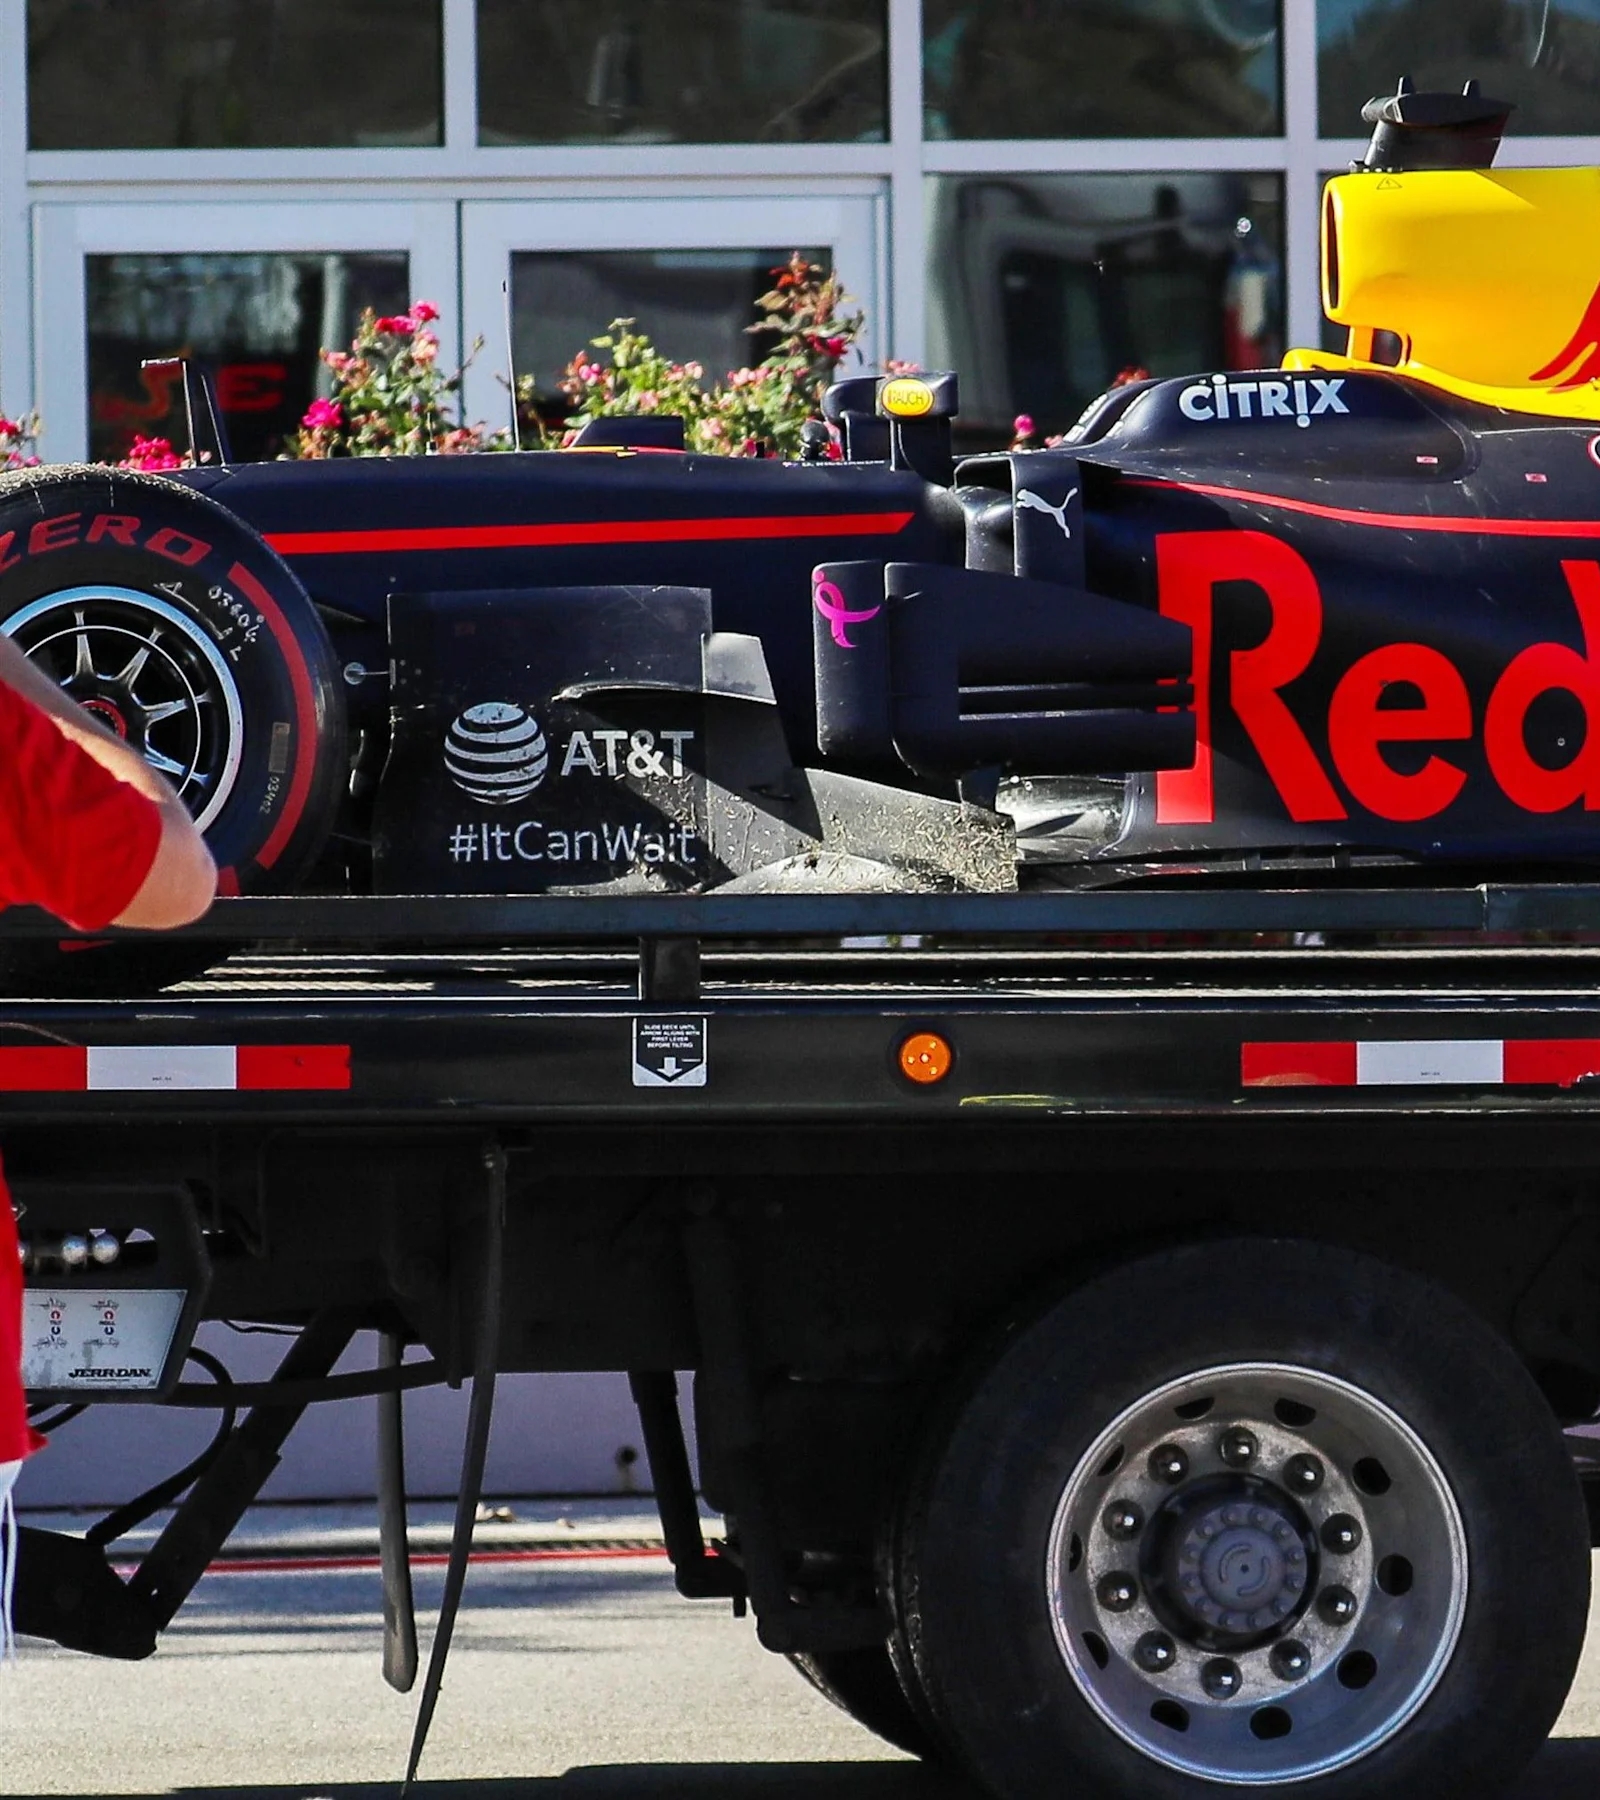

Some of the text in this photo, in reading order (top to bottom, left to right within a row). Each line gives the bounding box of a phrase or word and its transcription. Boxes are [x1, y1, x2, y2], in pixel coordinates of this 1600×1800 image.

[887, 390, 924, 406] RAUCH
[560, 730, 695, 778] AT&T
[449, 820, 696, 863] #ItCanWait
